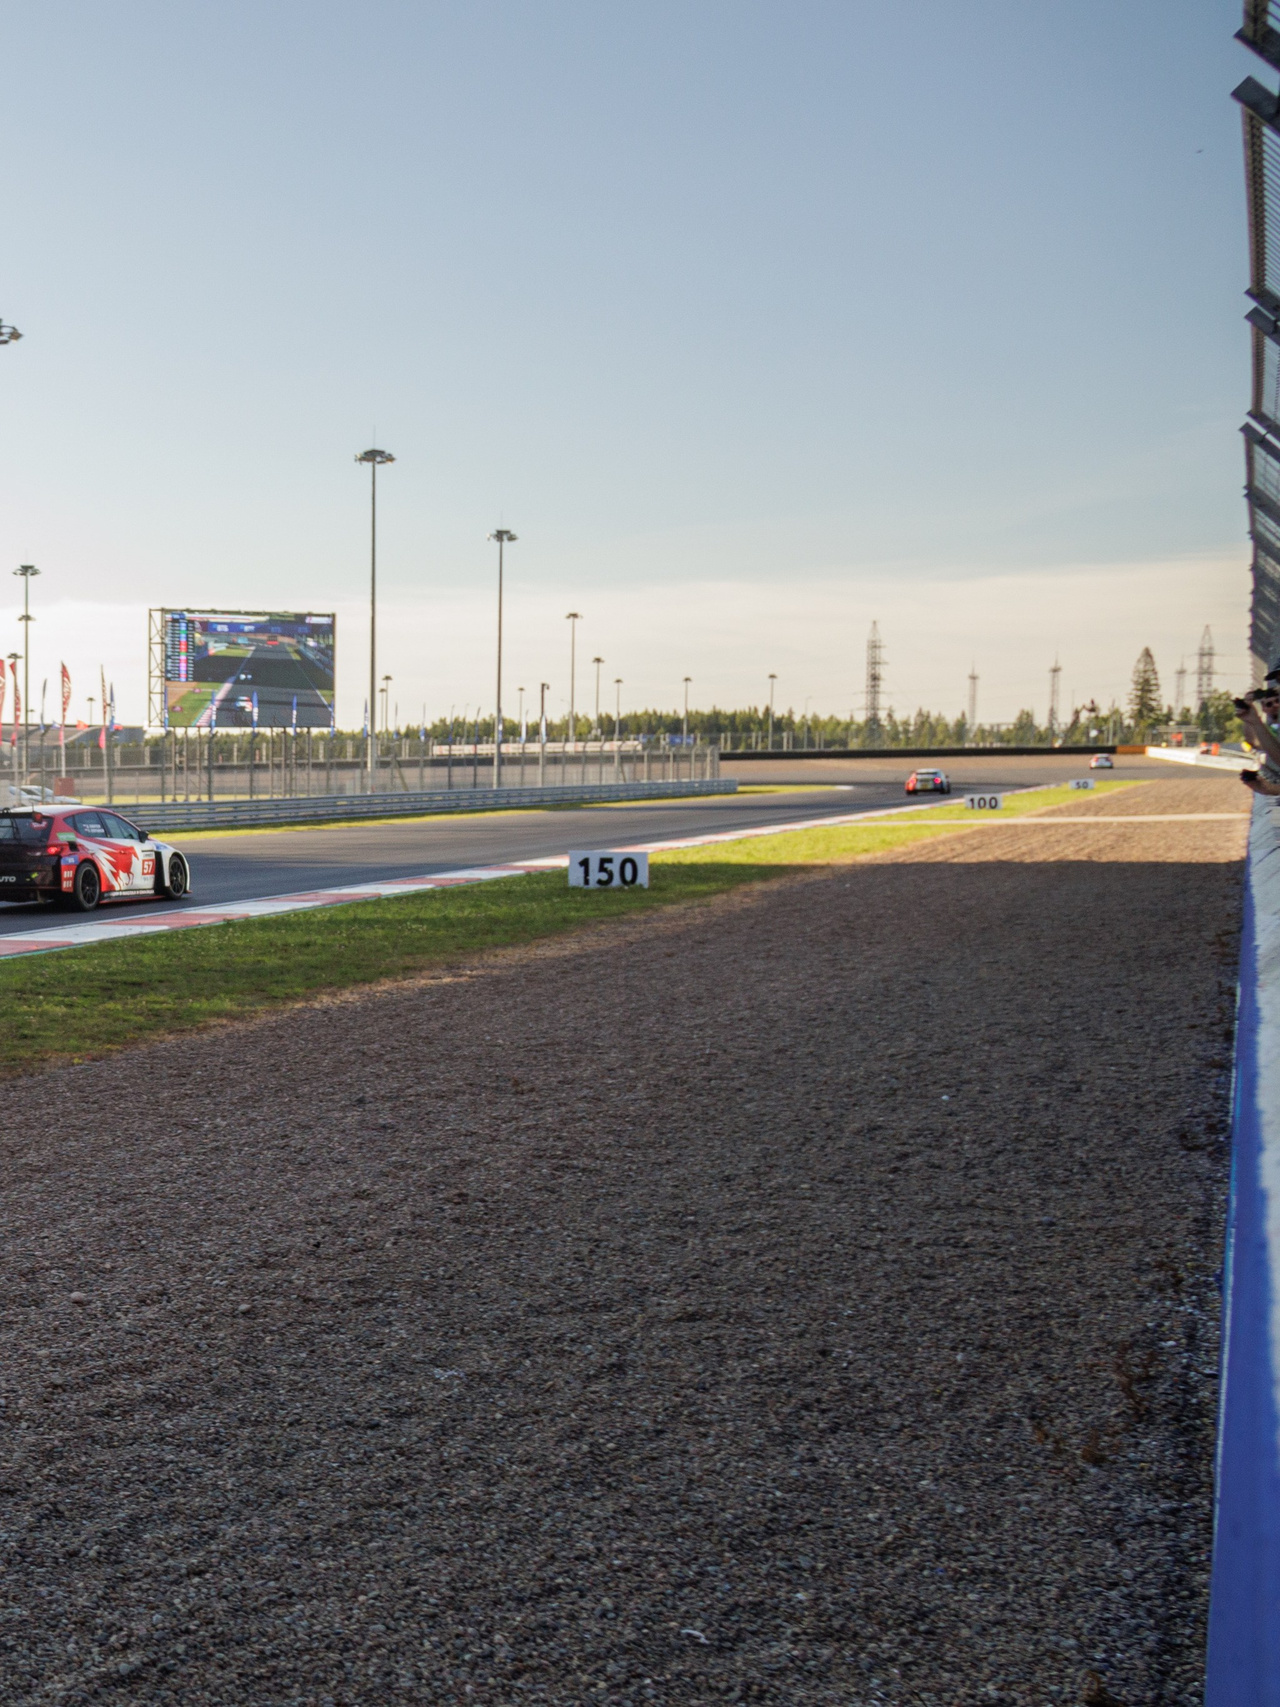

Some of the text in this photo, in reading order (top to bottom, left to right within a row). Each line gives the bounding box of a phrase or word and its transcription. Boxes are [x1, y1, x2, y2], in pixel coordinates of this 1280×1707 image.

[969, 797, 998, 810] 100
[143, 861, 153, 873] 57
[578, 857, 638, 886] 150
